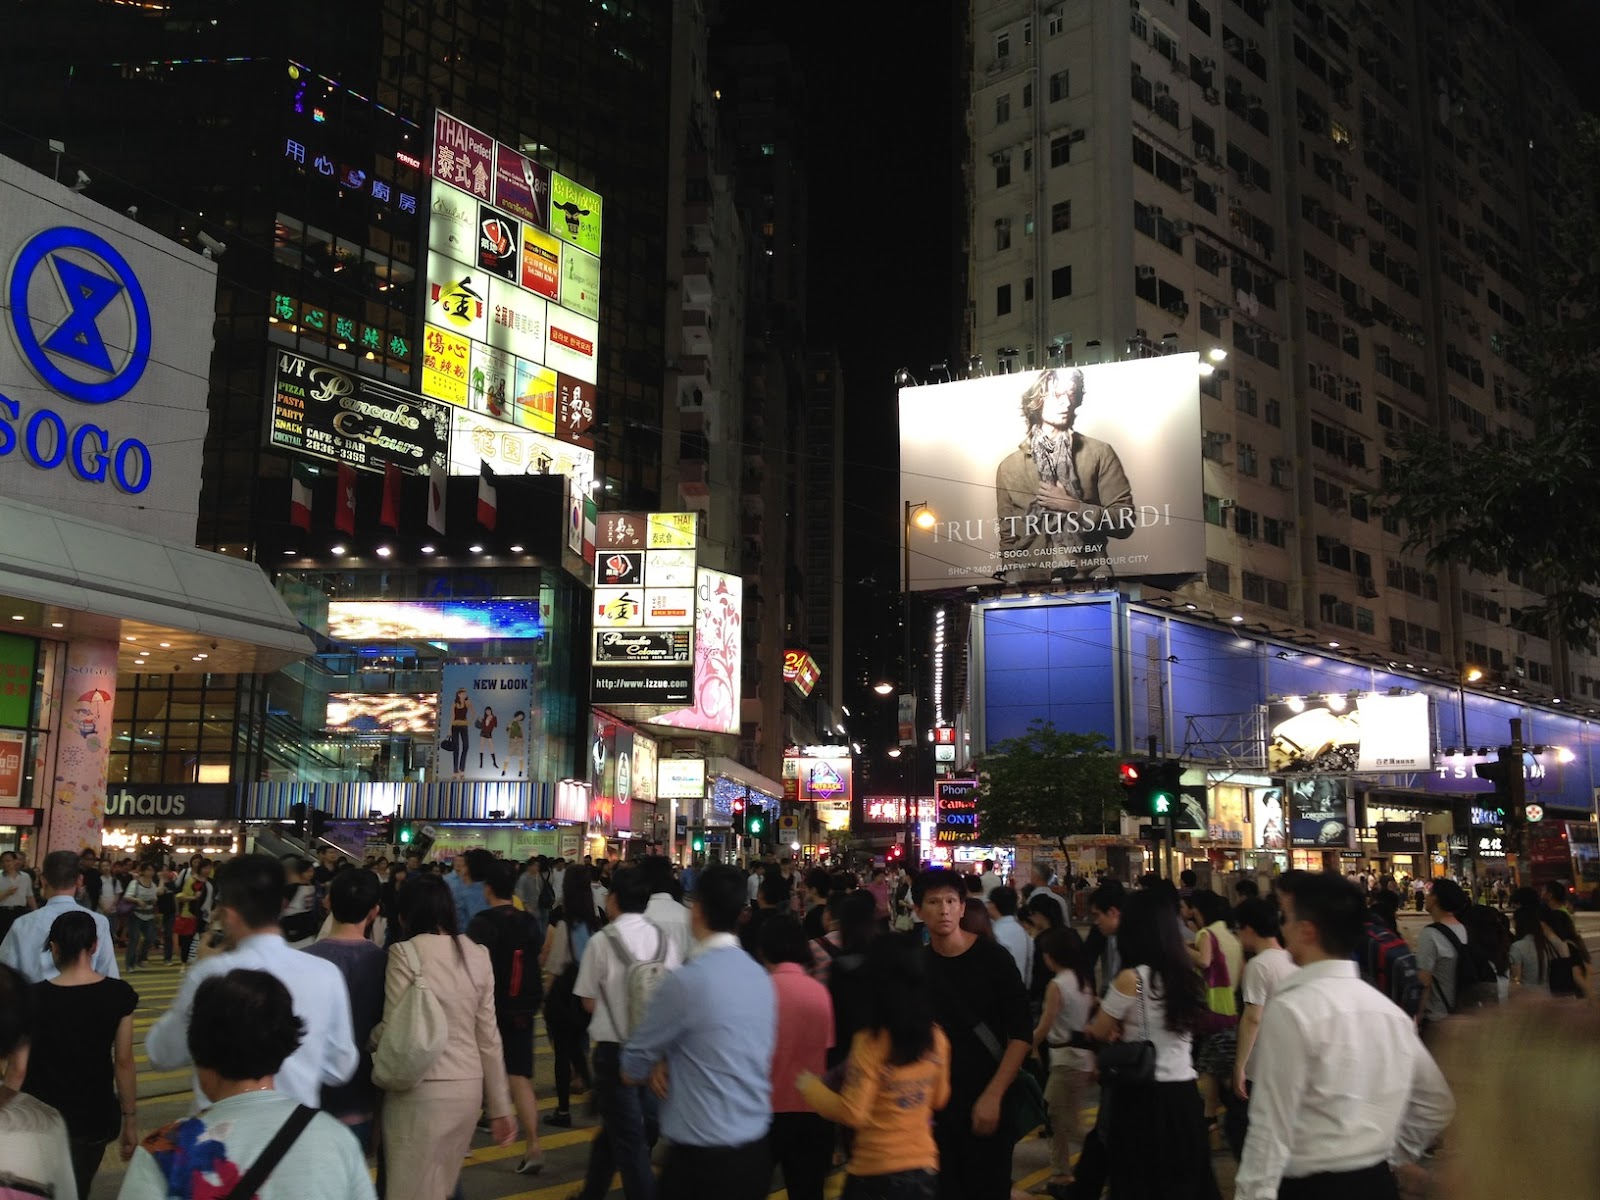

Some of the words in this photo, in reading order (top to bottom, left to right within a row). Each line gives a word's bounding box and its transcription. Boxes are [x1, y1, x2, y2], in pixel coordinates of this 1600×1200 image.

[438, 115, 468, 153] THAI
[468, 137, 492, 161] Perfect
[396, 152, 421, 169] PERFECT
[437, 145, 489, 198] 泰式食
[534, 178, 547, 195] 8/F
[427, 331, 467, 359] 傷心
[279, 355, 306, 378] 4/F
[278, 381, 306, 398] PIZZA
[277, 393, 305, 409] PASTA
[309, 366, 420, 431] Pancake
[276, 406, 304, 422] PARTY
[275, 418, 303, 435] SNACK
[0, 393, 152, 494] SOGO
[306, 427, 334, 444] CAFE
[333, 435, 342, 447] &
[345, 438, 366, 453] BAR
[305, 438, 366, 464] 2836-3355
[673, 515, 691, 525] THAI
[1003, 503, 1171, 538] TRUSSARDI
[1003, 550, 1032, 560] SOGO,
[1033, 545, 1084, 557] CAUSEWAY
[1084, 544, 1104, 554] BAY
[948, 567, 971, 576] SHOP
[1039, 559, 1078, 570] ARCADE,
[1080, 557, 1126, 567] HARBOUR
[1127, 555, 1149, 564] CITY
[785, 652, 806, 672] 24
[70, 666, 109, 676] SOGO
[473, 679, 498, 690] NEW
[500, 679, 528, 690] LOOK
[596, 678, 688, 690] http://www.izzue.com
[939, 813, 974, 823] SONY
[939, 831, 975, 841] Nikon
